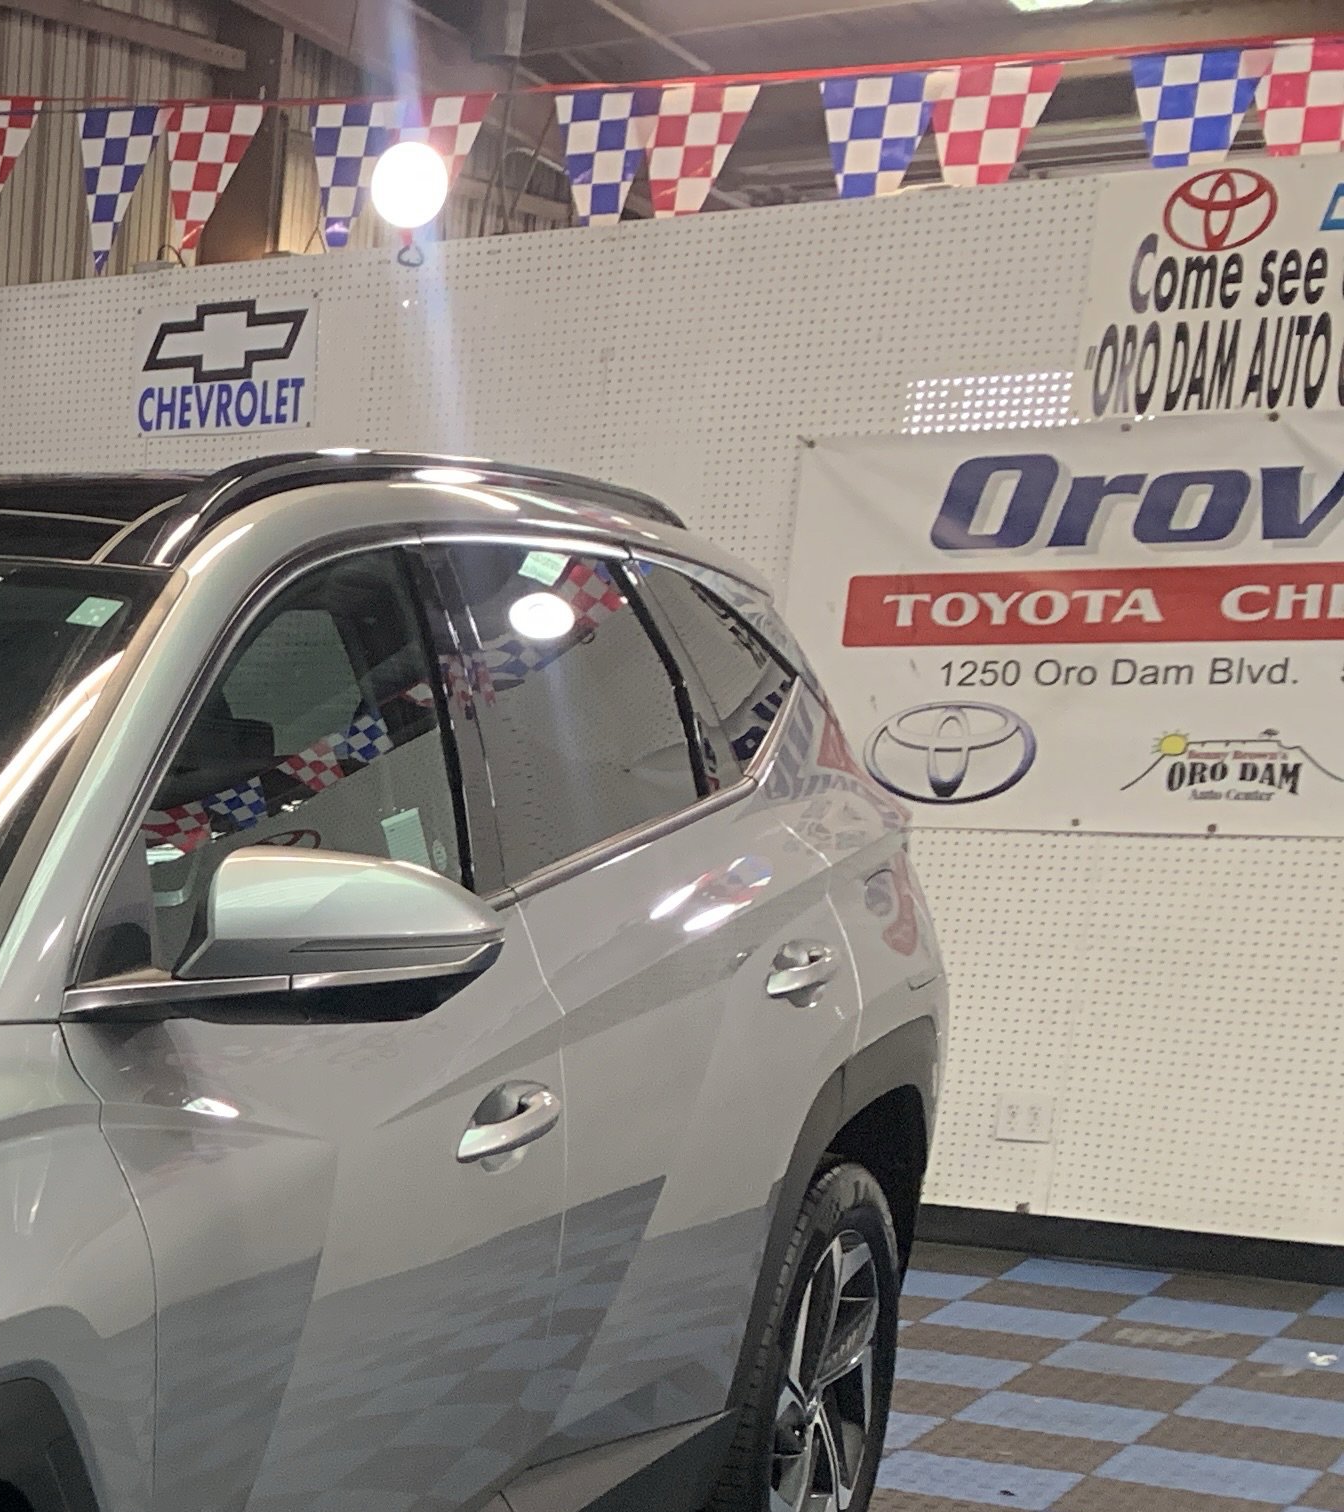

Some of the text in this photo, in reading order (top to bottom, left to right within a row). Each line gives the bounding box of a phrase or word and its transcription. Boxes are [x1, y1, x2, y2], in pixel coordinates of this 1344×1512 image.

[1129, 232, 1329, 314] Come see
[1084, 311, 1332, 417] "ORO DAM AUTO
[138, 377, 305, 432] CHEVROLET
[882, 588, 1164, 628] TOYOTA
[939, 656, 1300, 688] 1250 Oro Dam Blvd.
[1167, 761, 1303, 795] ORO DAM
